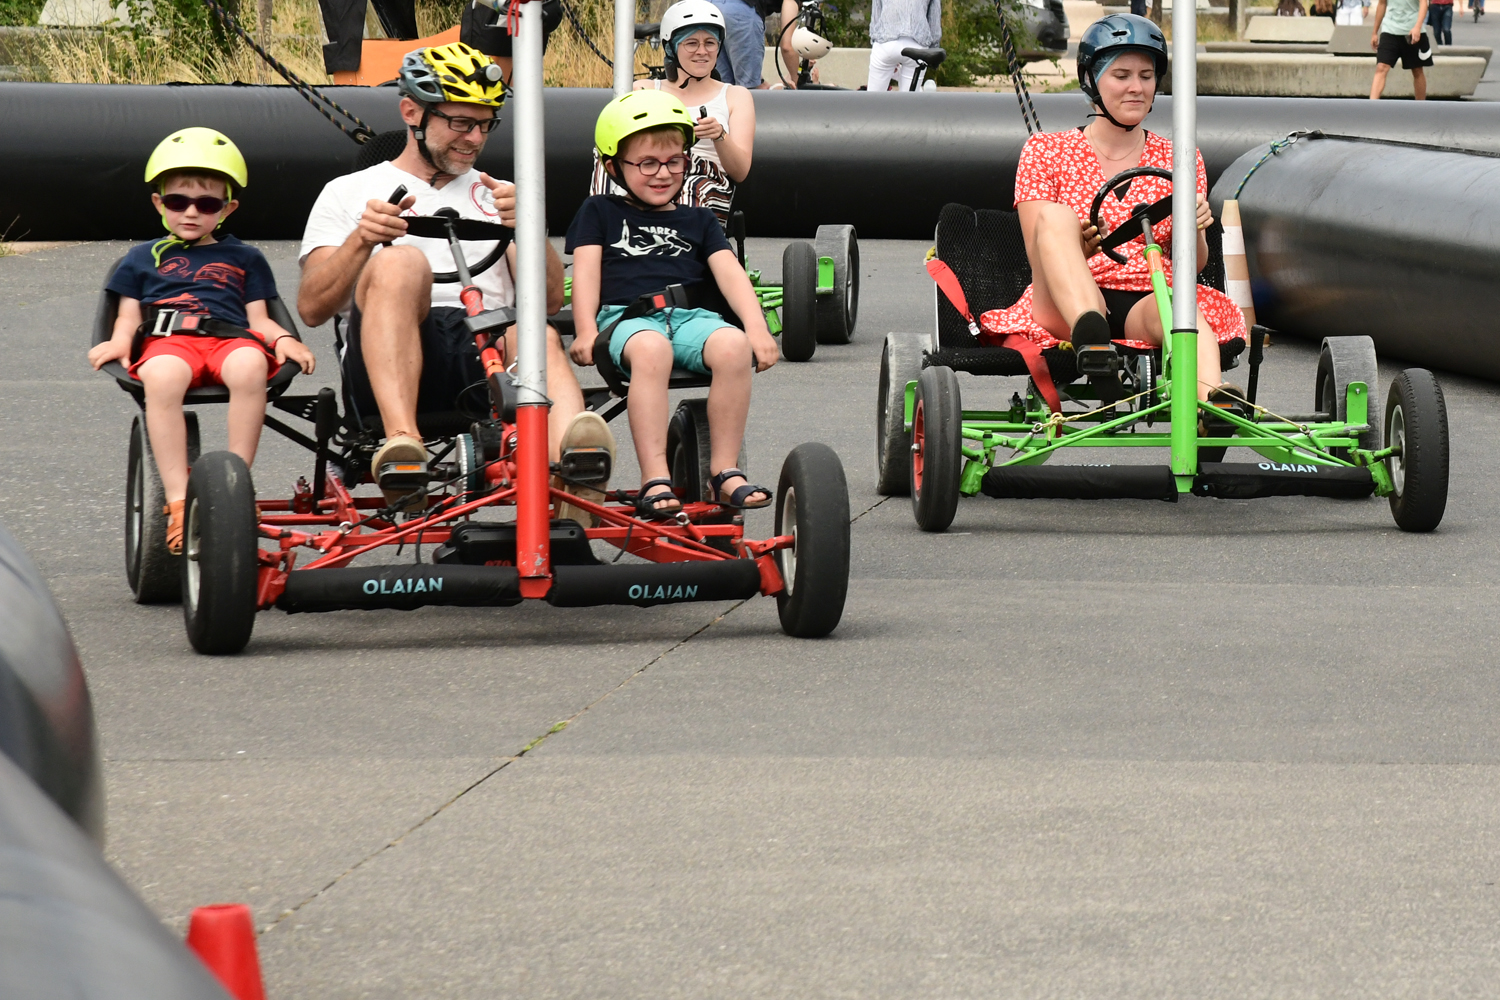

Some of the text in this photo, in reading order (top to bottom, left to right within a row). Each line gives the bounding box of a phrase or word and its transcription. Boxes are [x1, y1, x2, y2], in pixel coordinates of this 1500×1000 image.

[1258, 463, 1318, 474] OLAIAN
[363, 577, 444, 595] OLAIAN
[628, 584, 699, 600] OLAIAN
